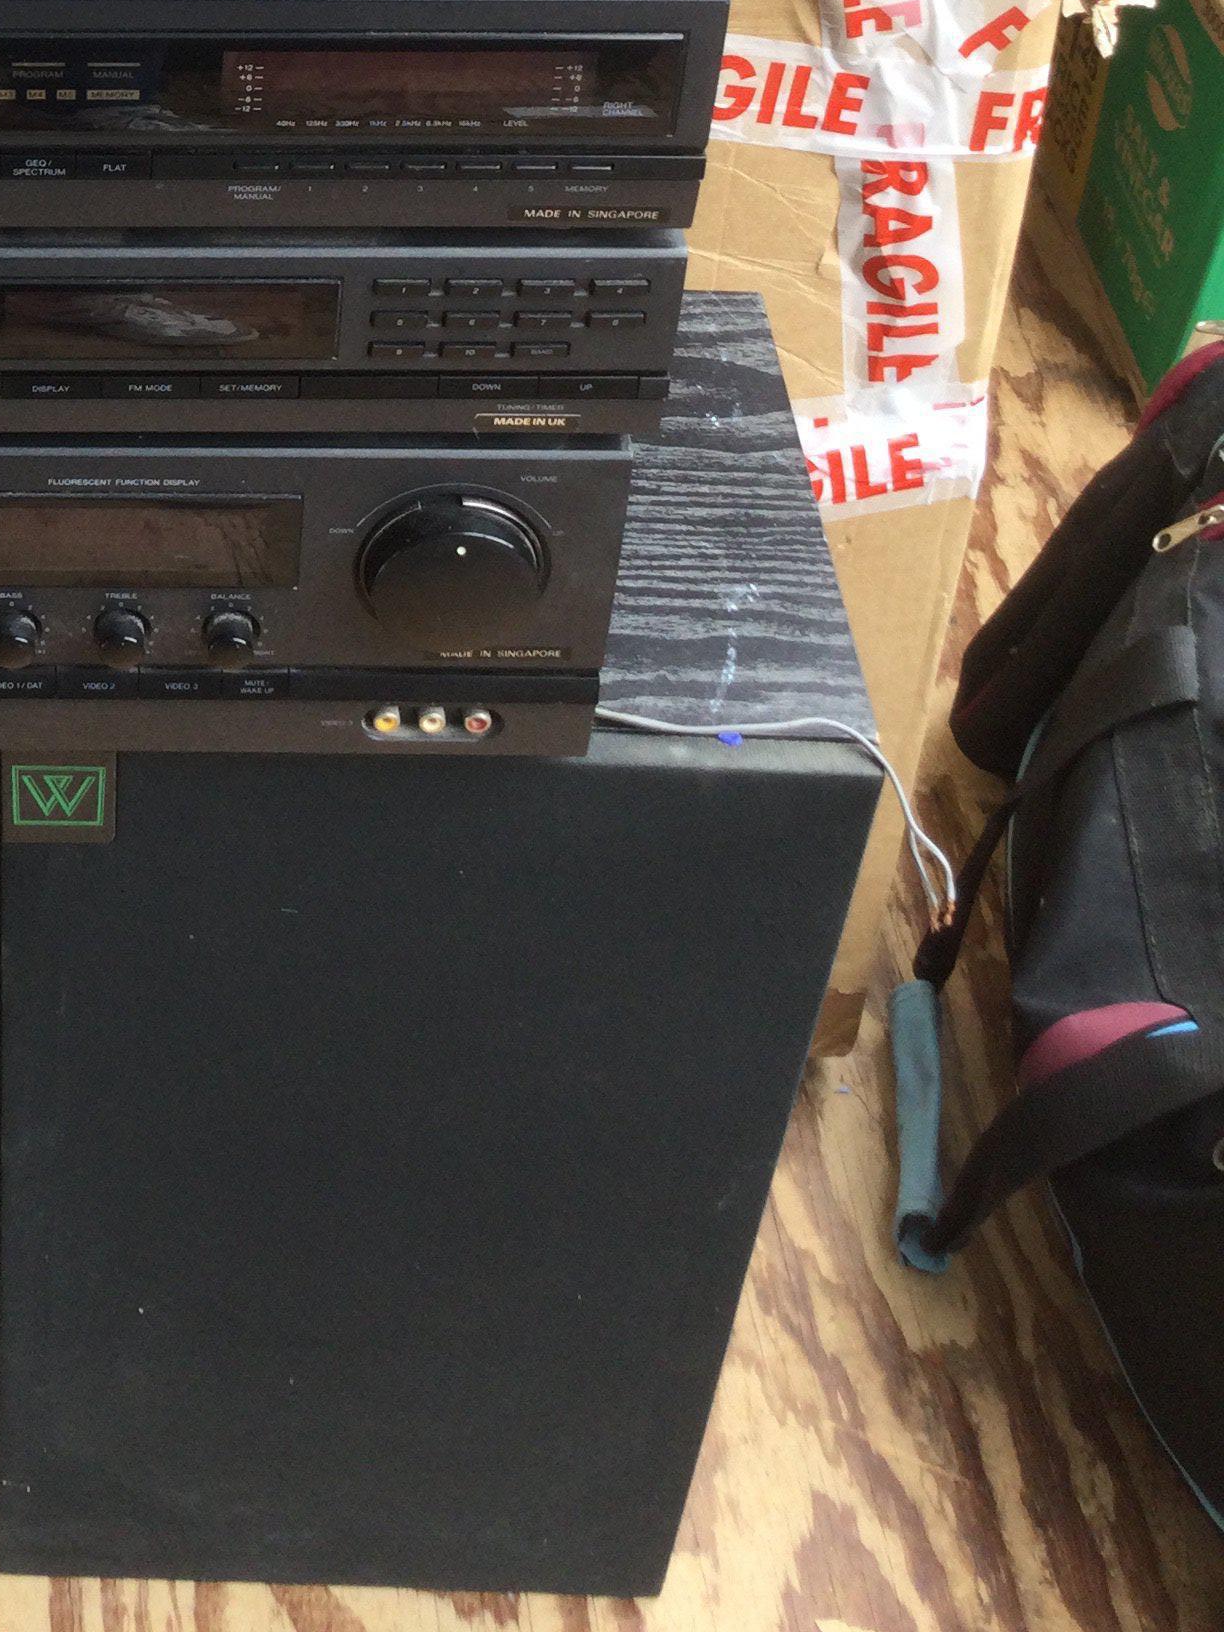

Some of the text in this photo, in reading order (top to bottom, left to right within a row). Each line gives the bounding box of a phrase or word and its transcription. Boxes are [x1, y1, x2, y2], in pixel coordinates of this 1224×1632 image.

[12, 167, 66, 177] SPECTRUM
[102, 163, 128, 173] FLAT
[523, 209, 661, 220] MADE IN SINGAPORE
[32, 385, 71, 394] DISPLAY
[472, 383, 502, 391] DOWN
[493, 417, 566, 427] MADE UK
[47, 478, 201, 487] FLUORESCENT FUNCTION DISPLAY
[497, 649, 562, 659] SINGAPORE
